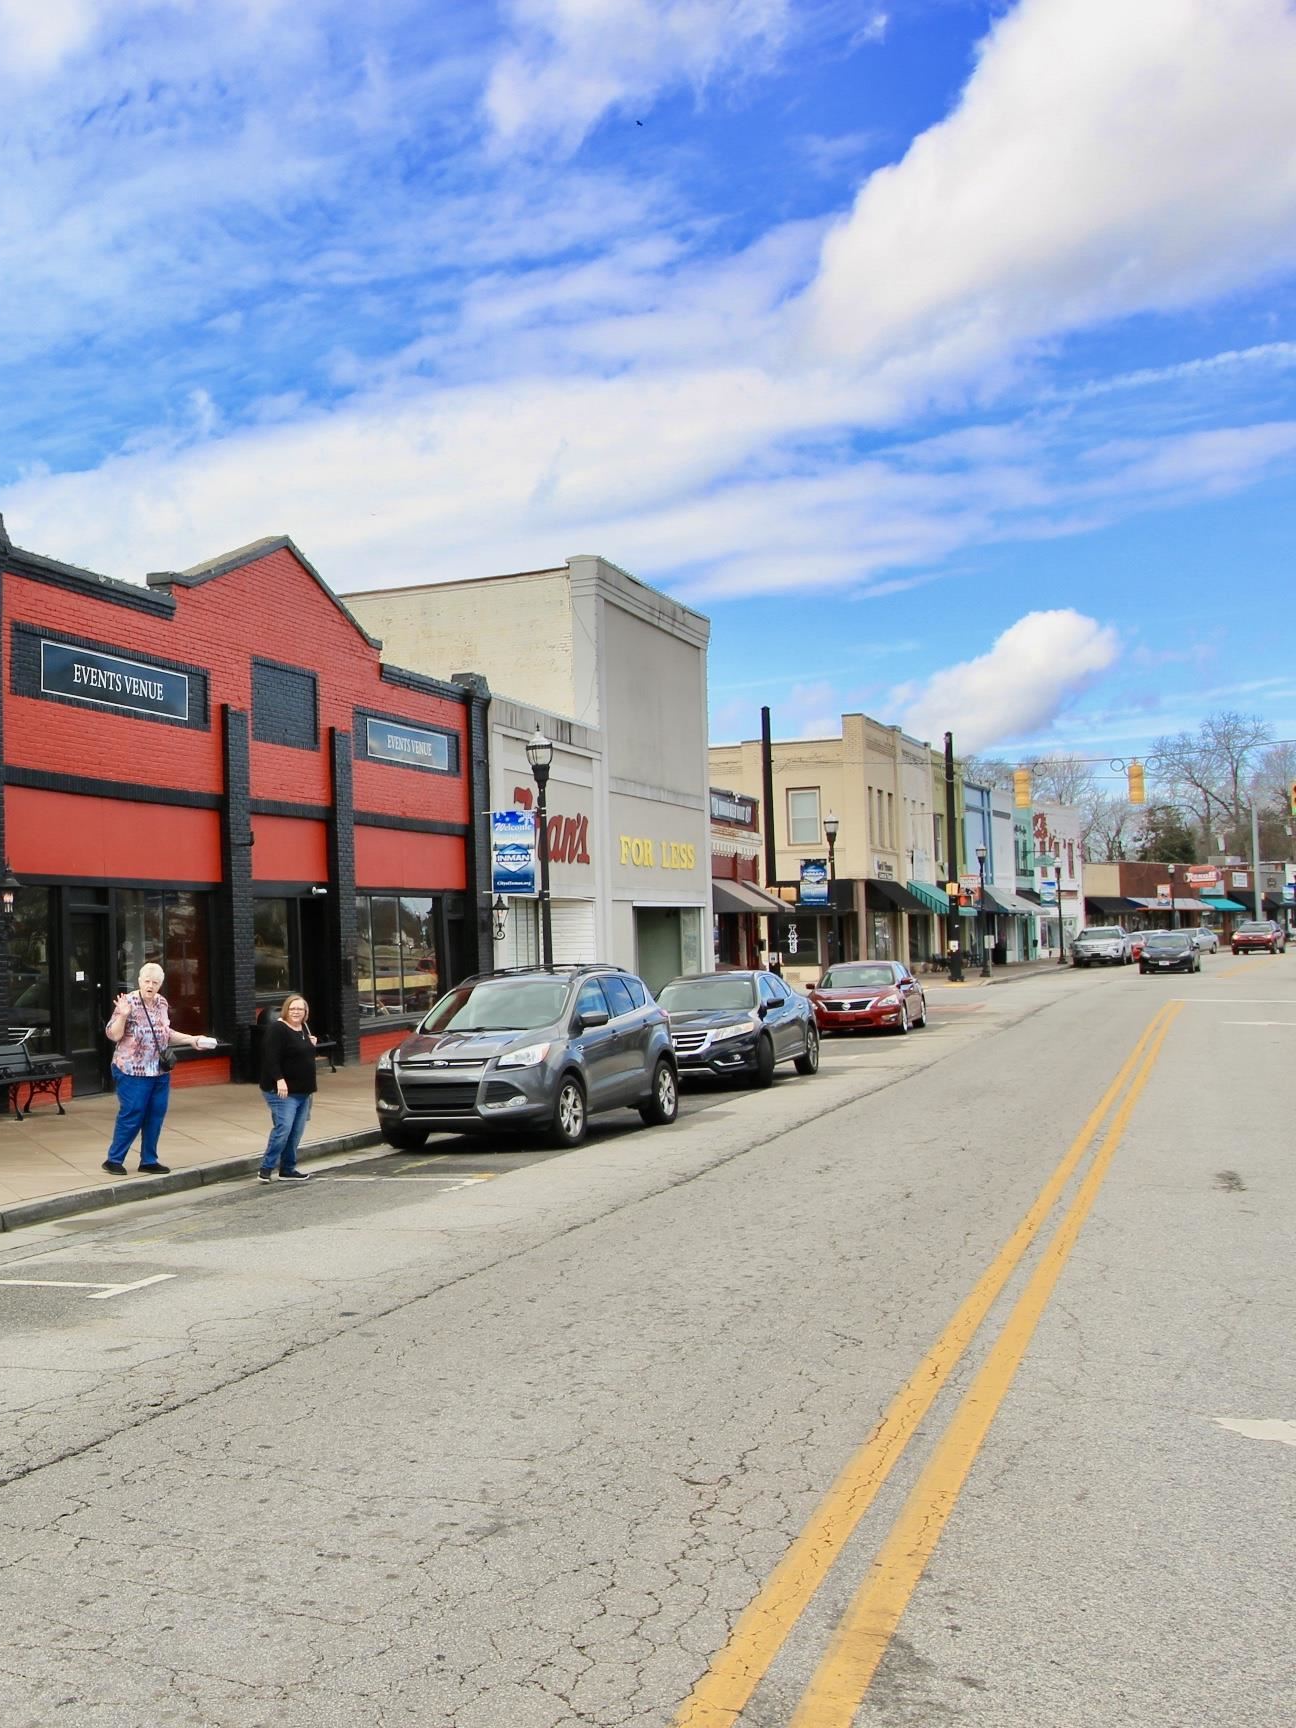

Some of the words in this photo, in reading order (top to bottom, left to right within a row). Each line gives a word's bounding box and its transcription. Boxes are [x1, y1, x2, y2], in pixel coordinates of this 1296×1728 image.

[72, 663, 122, 693] EVENTS
[124, 675, 164, 701] VENUE
[387, 735, 411, 752] EVENTS
[411, 741, 432, 756] VENUE
[497, 854, 530, 862] INMAN
[620, 835, 655, 868] FOR
[661, 841, 696, 870] LESS
